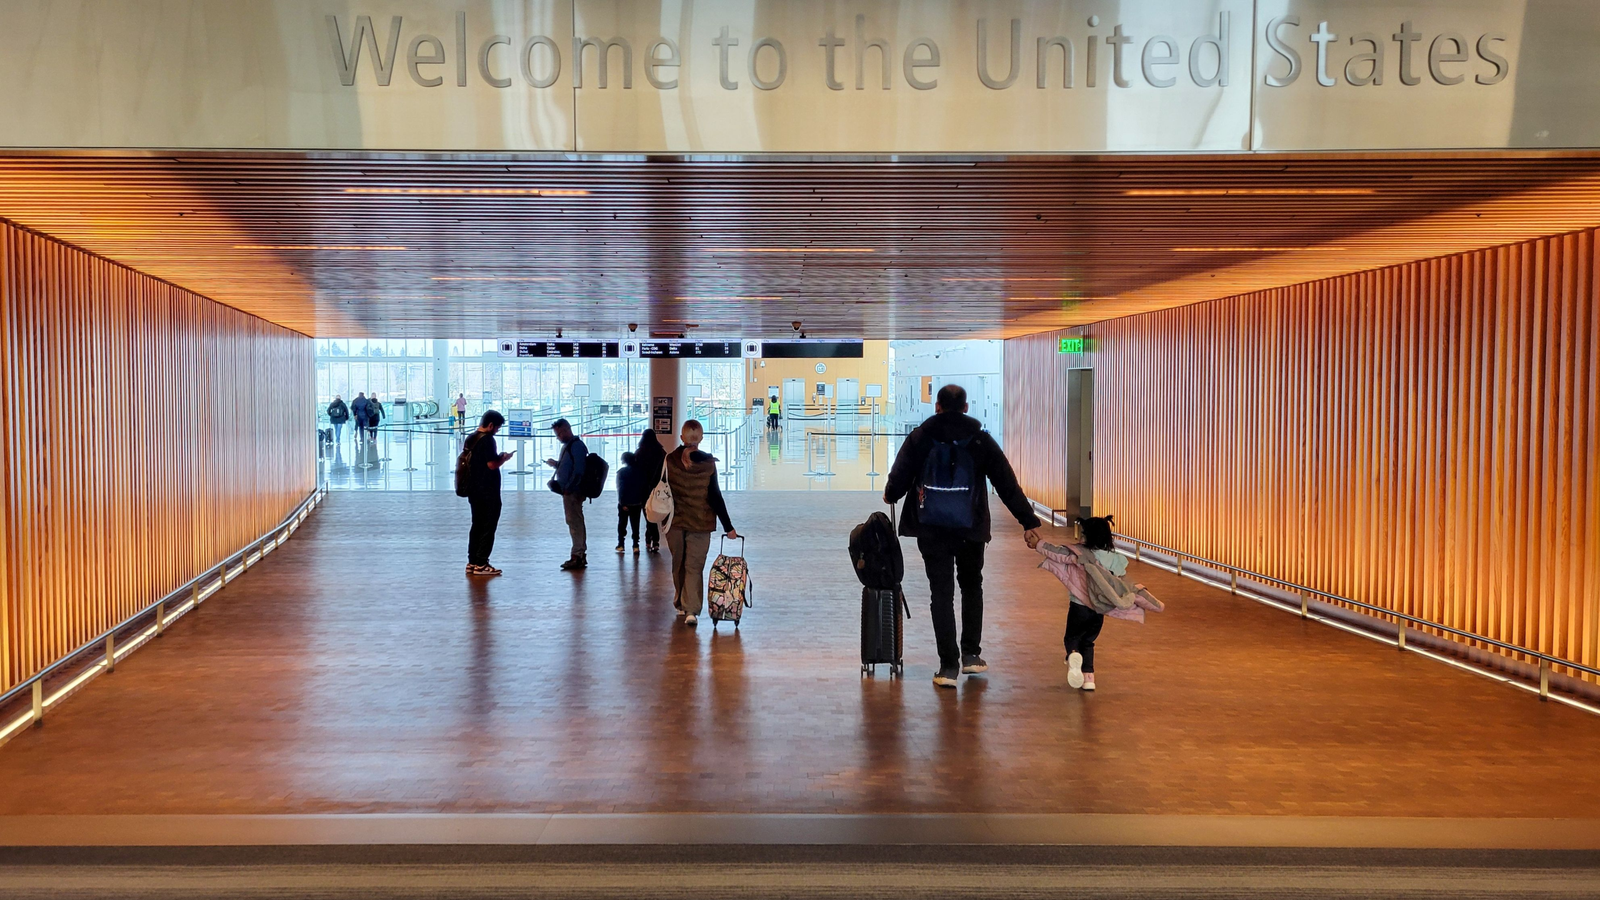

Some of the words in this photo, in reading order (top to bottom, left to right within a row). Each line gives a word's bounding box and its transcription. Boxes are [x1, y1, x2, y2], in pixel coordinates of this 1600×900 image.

[325, 11, 681, 91] Welcome
[712, 25, 788, 91] to
[818, 14, 941, 91] the
[976, 11, 1231, 91] United
[1263, 15, 1510, 88] States
[1062, 338, 1080, 352] EXIT
